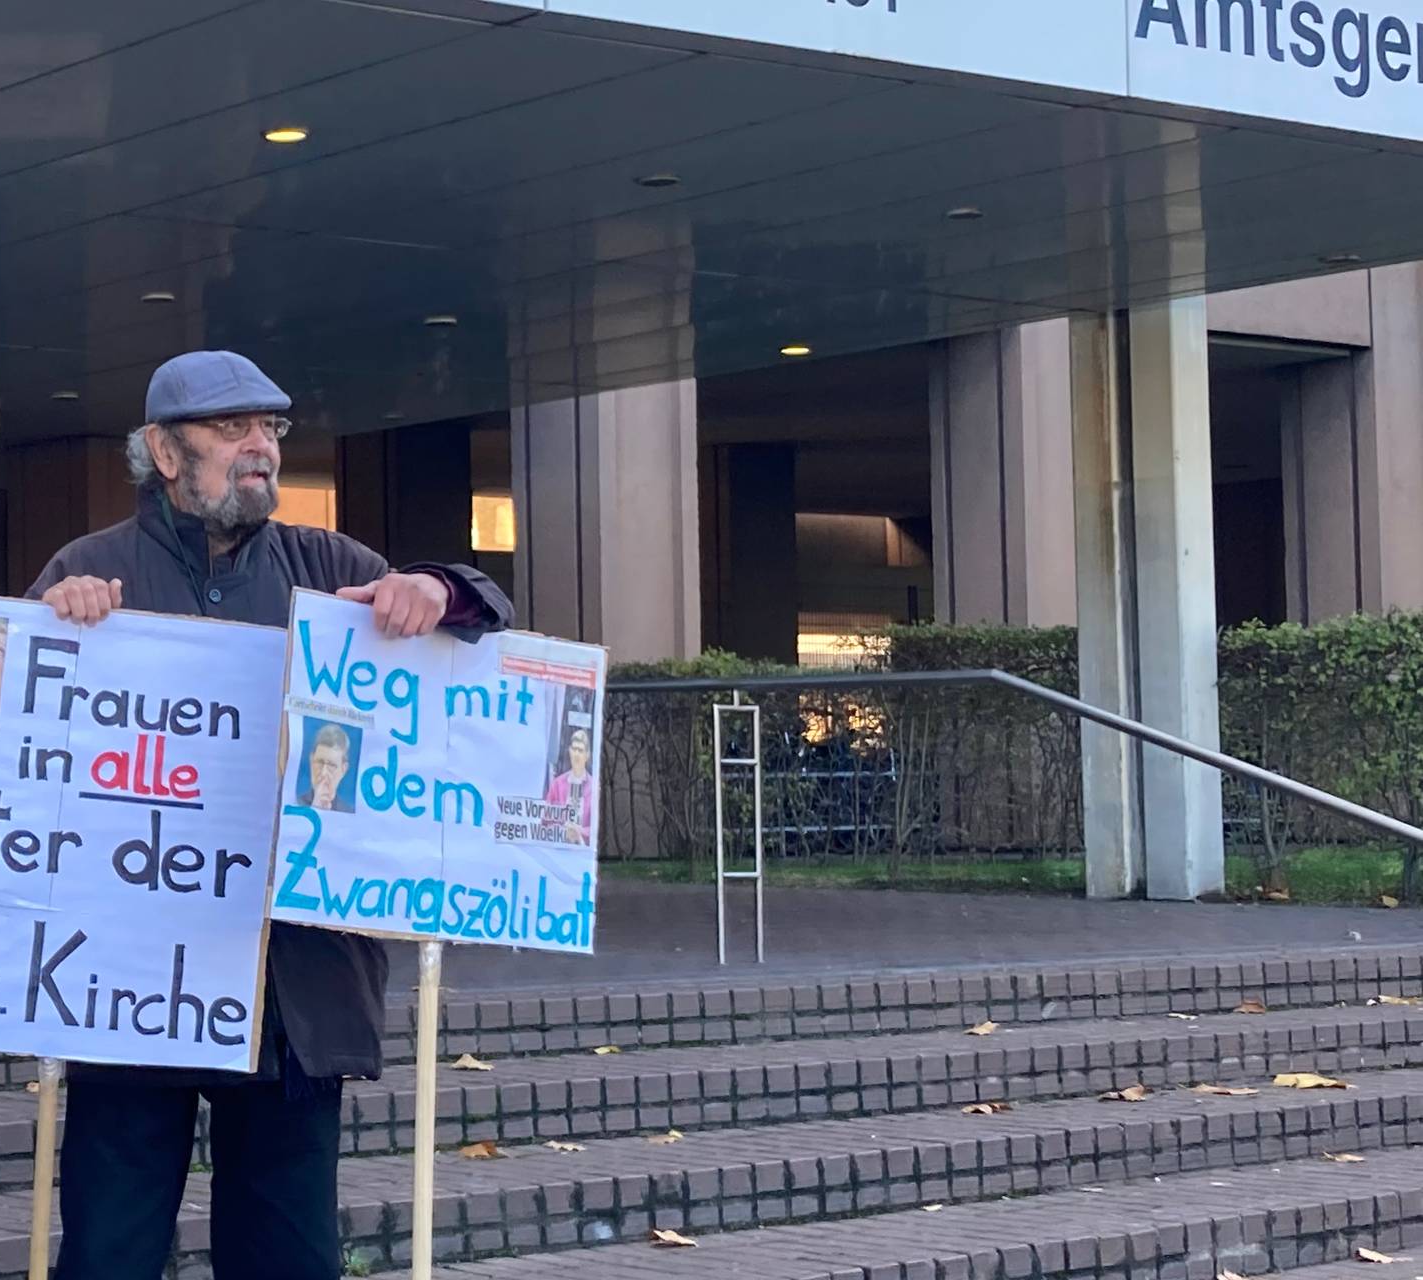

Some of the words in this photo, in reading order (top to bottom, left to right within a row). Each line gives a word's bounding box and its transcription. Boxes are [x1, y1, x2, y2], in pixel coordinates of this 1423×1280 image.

[1135, 0, 1423, 98] Amtsge
[22, 636, 241, 739] Frauen
[298, 619, 419, 745] Weg
[445, 676, 534, 725] mit
[19, 735, 73, 783] in
[90, 734, 201, 799] alle
[360, 745, 484, 827] dem
[112, 810, 252, 898] der
[273, 805, 594, 947] Zwangszölibat
[494, 821, 527, 841] gegen
[24, 920, 248, 1046] Kirche
